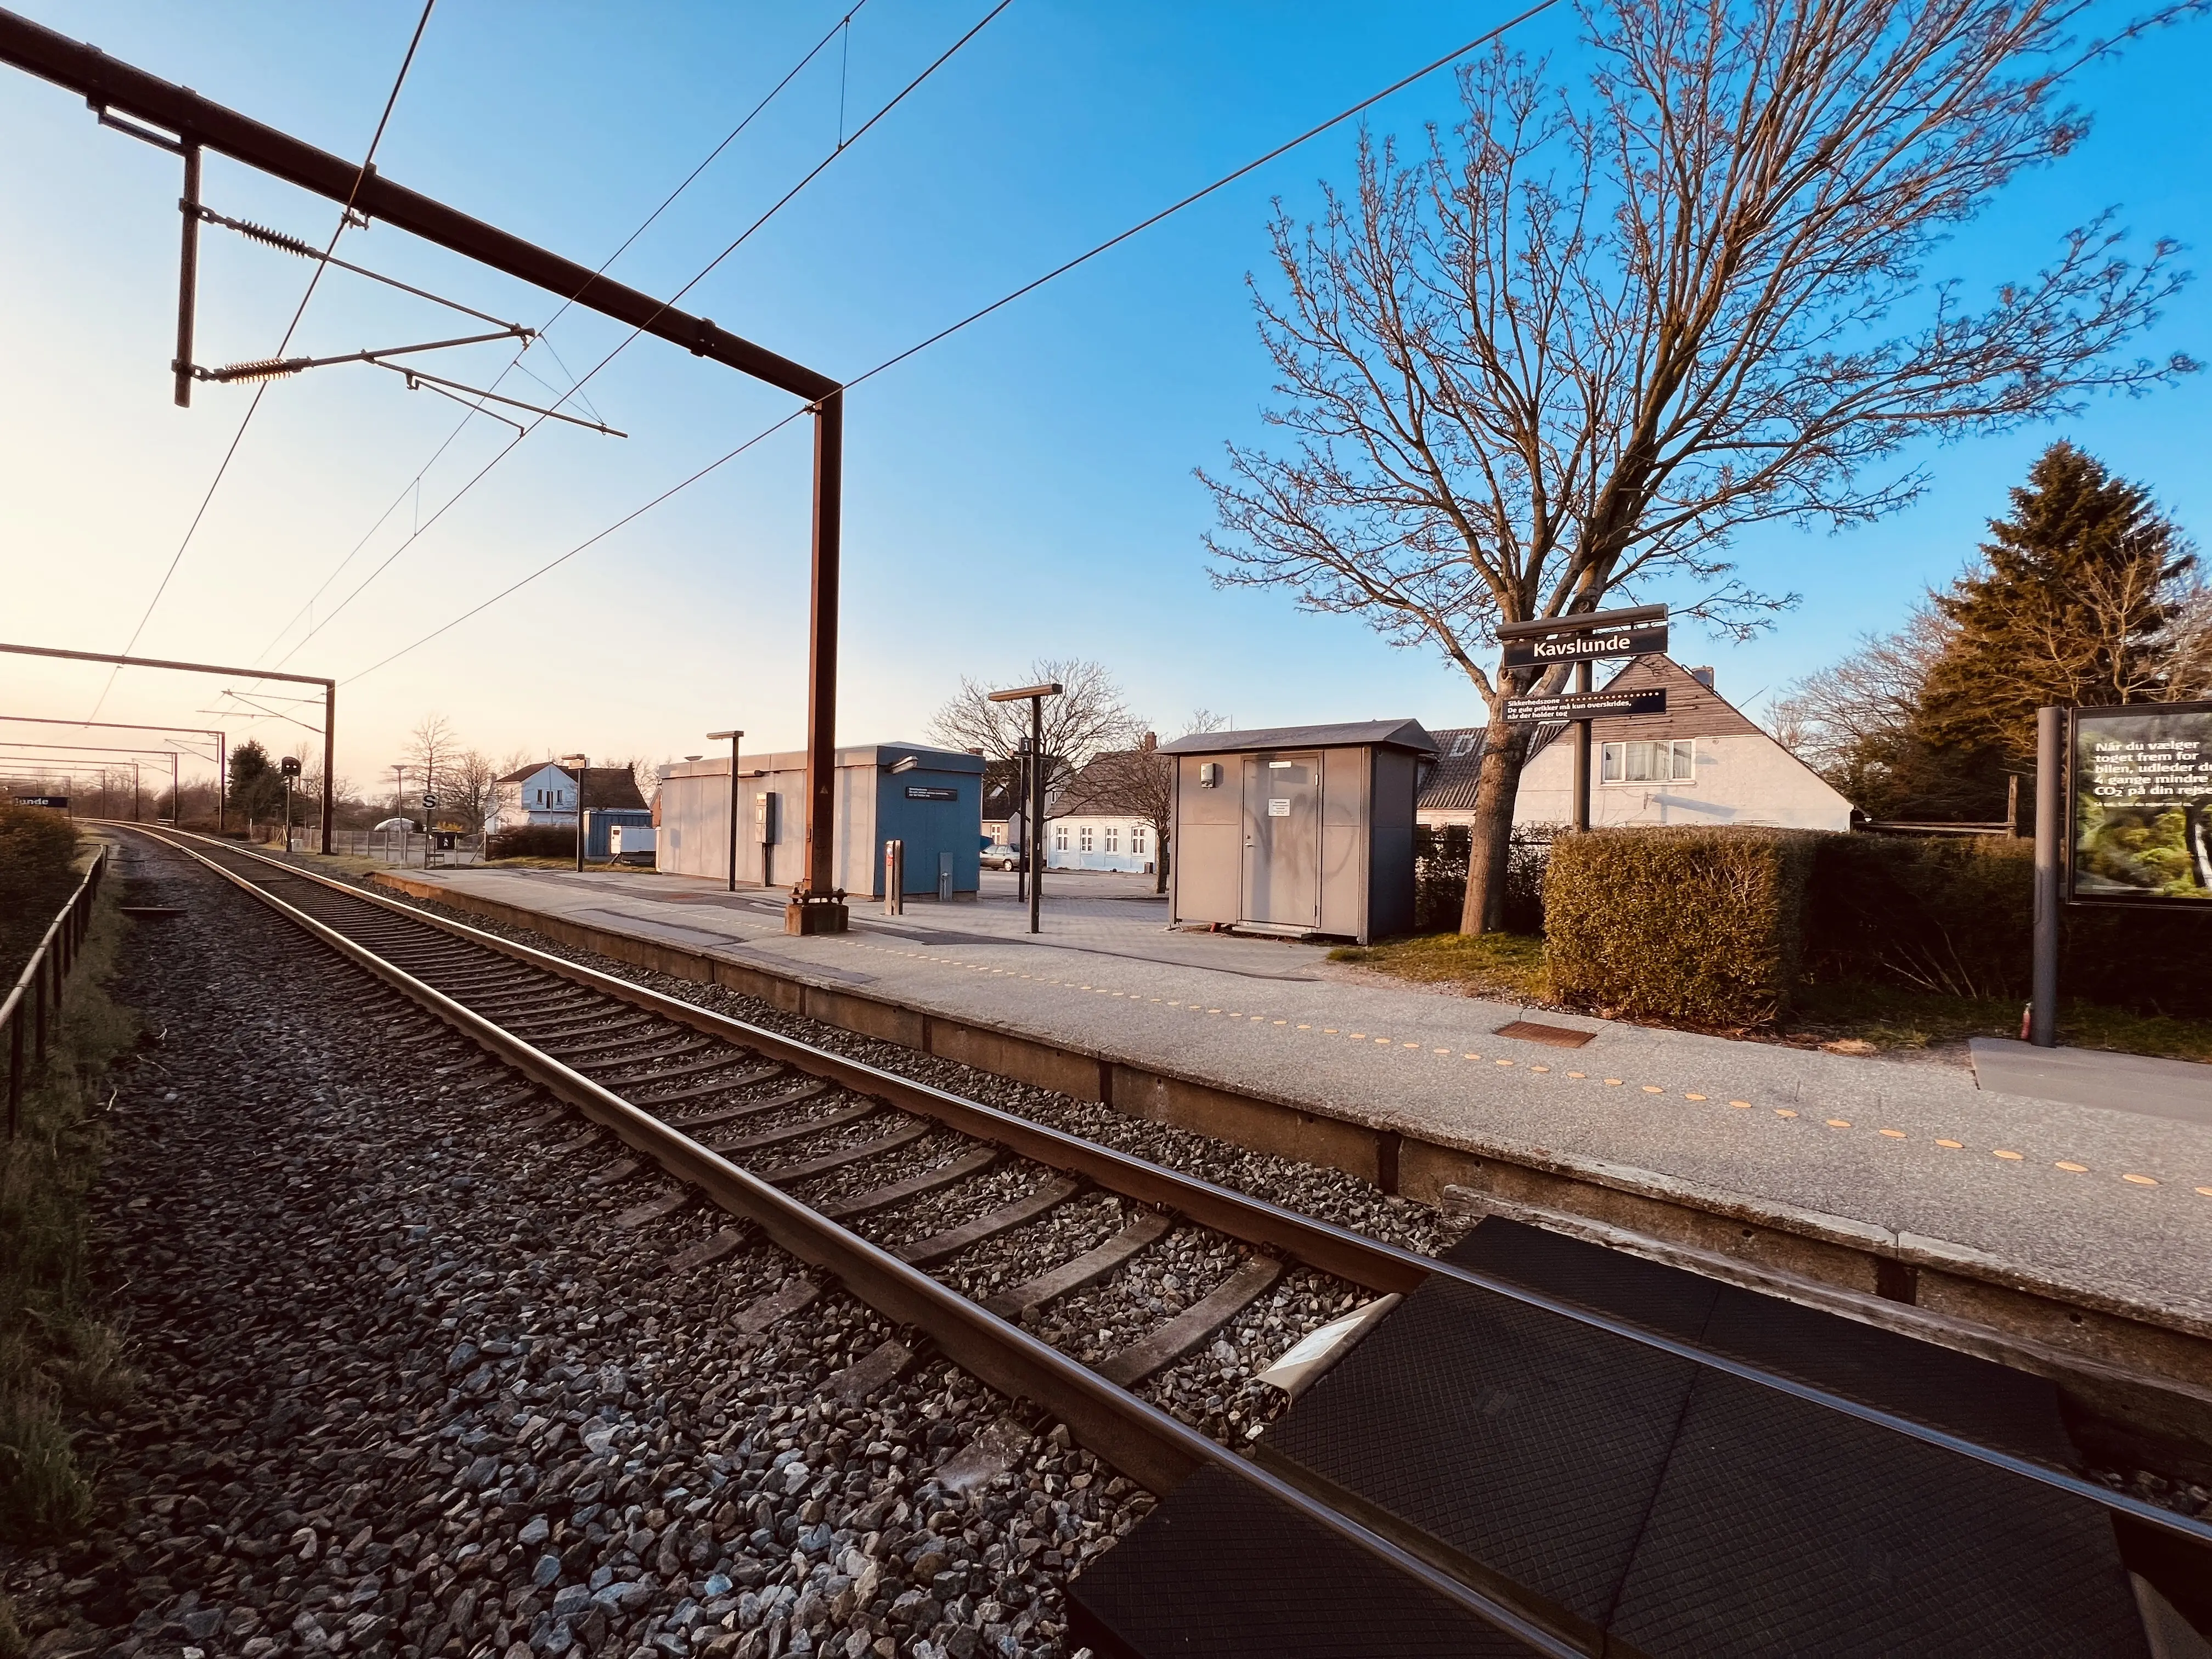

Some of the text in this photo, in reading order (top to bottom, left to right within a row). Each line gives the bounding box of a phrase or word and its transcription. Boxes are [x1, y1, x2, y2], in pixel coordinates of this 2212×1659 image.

[1534, 635, 1630, 657] Kavslunde
[1508, 698, 1560, 707] Sikkerhedszone
[1587, 700, 1632, 708] overskrides,
[1024, 742, 1029, 751] 1
[2096, 741, 2200, 752] Når du vælger
[2095, 751, 2199, 764] toget frem for
[2095, 764, 2134, 774] bilen,
[2138, 763, 2195, 772] udleder
[2094, 774, 2209, 785] 4 gange mindre
[2128, 786, 2146, 795] på
[2150, 786, 2174, 795] din
[422, 795, 436, 808] S
